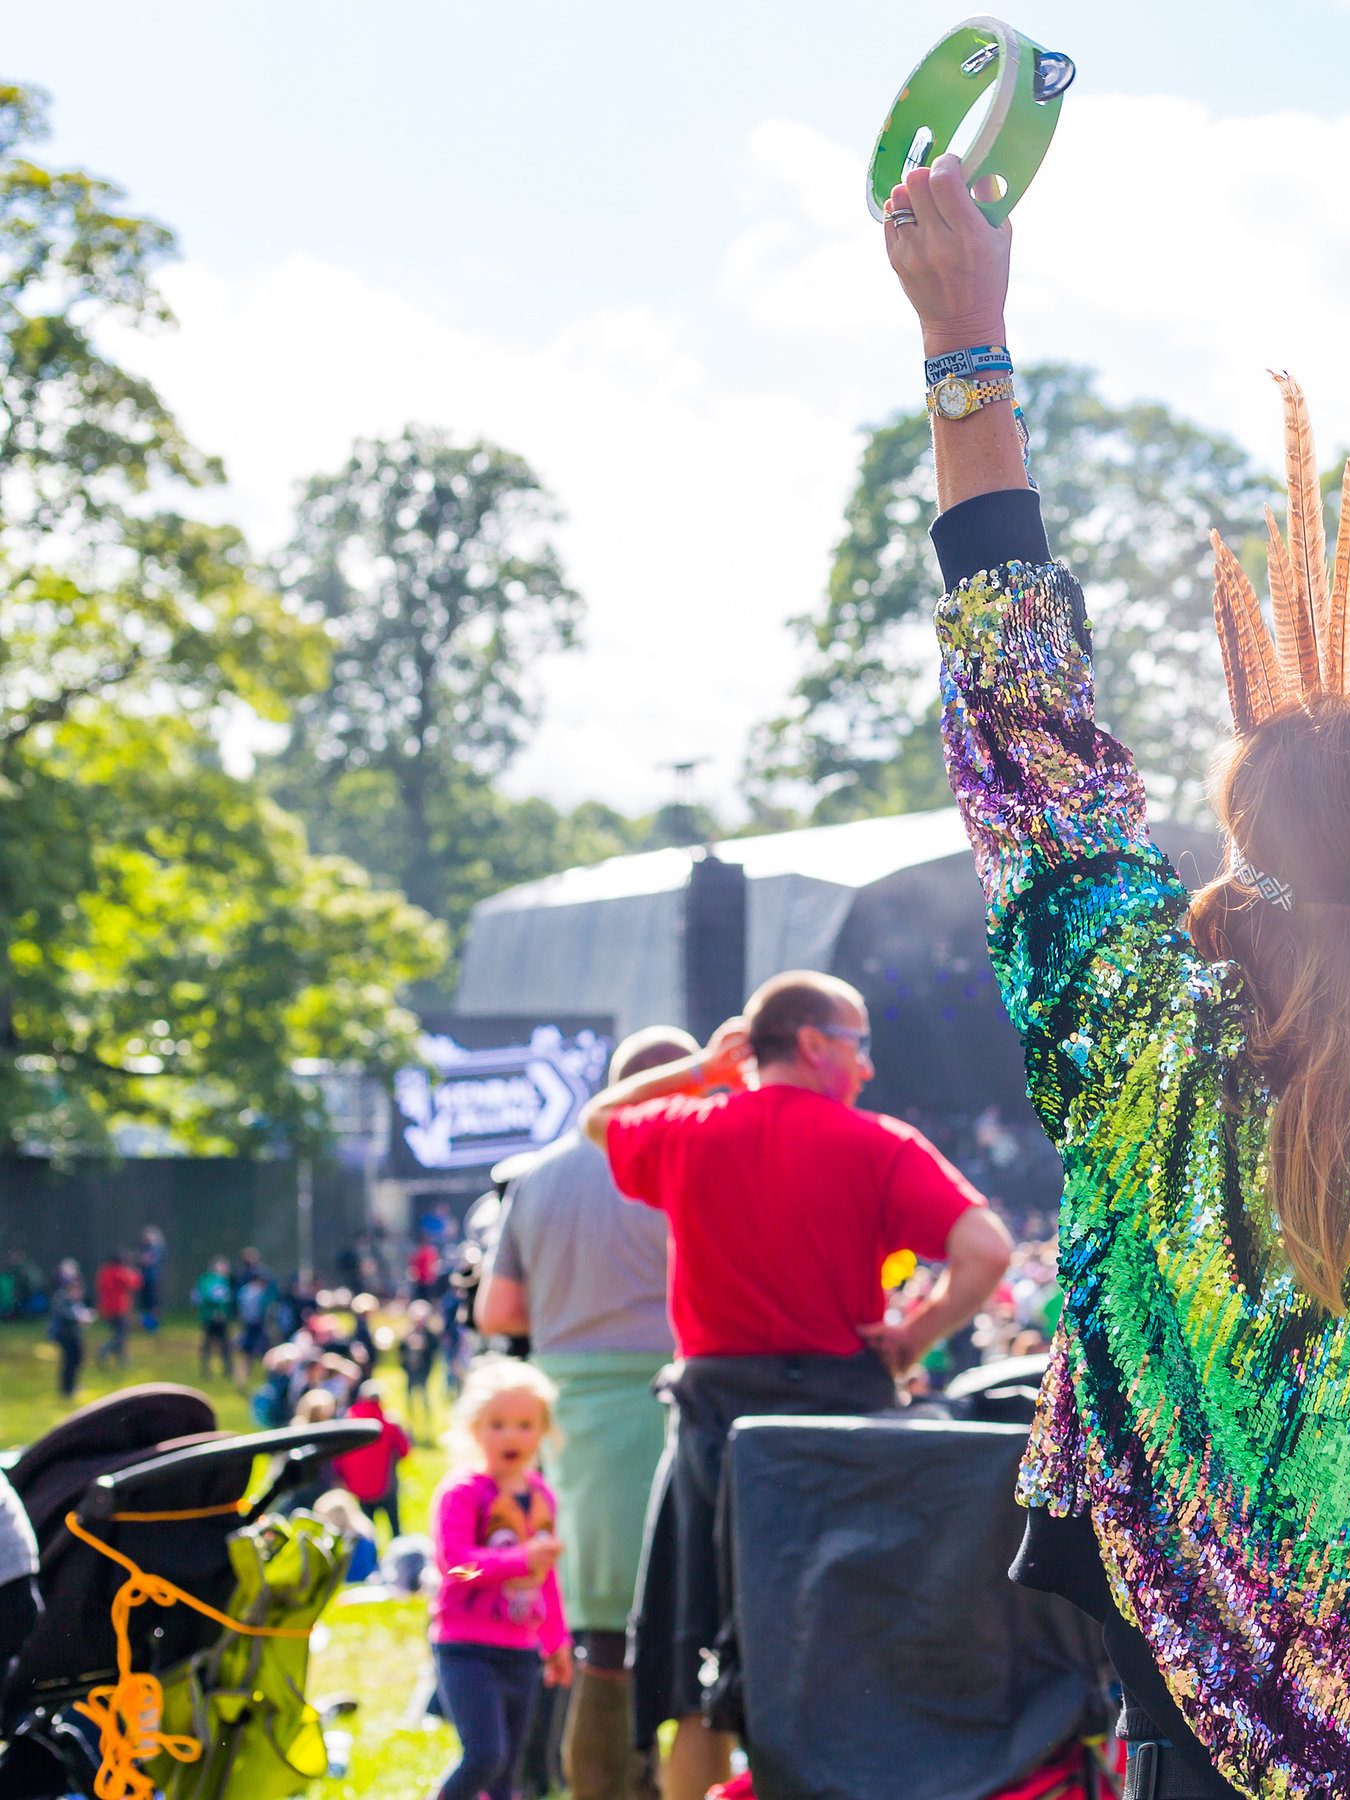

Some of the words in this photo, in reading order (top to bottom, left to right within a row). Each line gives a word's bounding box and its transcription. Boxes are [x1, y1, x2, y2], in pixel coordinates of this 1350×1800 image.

[928, 352, 965, 372] CALLING
[978, 354, 1005, 363] FIELDS
[930, 360, 968, 381] KENDAL
